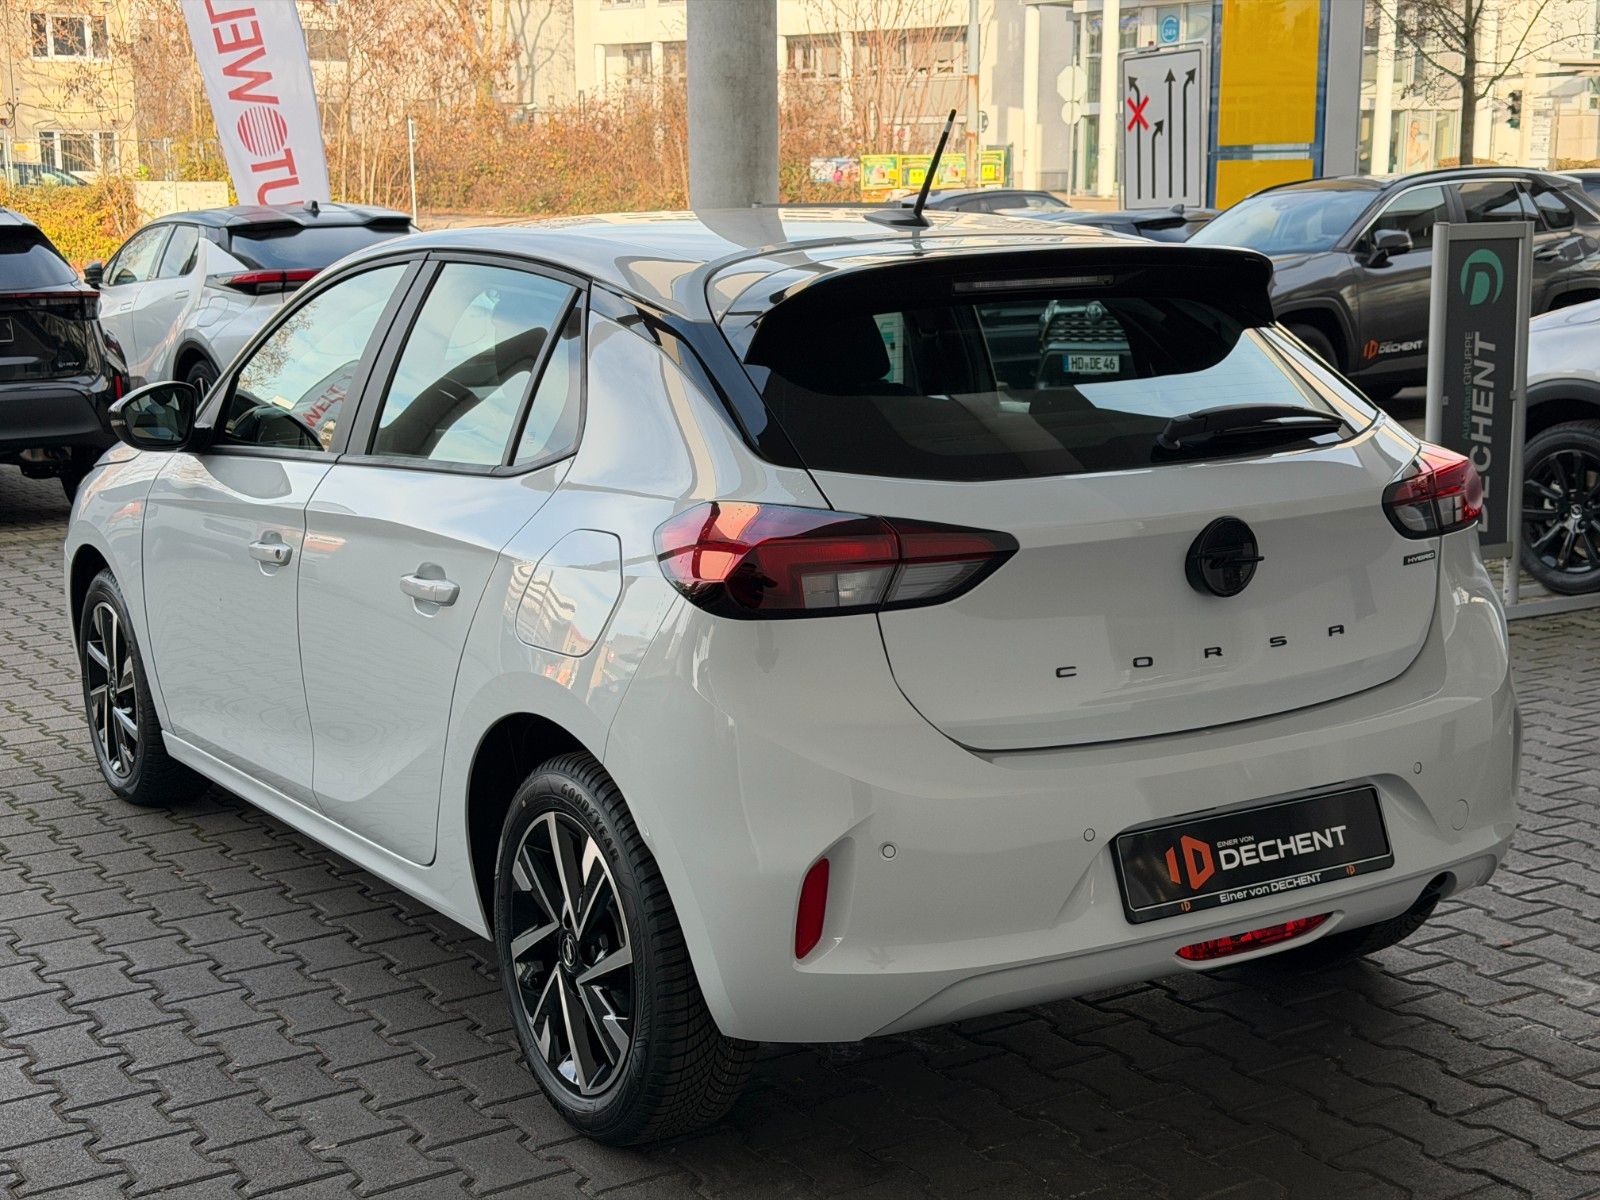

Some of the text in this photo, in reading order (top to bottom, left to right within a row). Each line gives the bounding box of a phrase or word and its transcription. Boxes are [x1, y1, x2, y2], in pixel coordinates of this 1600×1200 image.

[1378, 340, 1423, 354] DECHENT
[1071, 357, 1116, 370] HD DE 46
[1055, 624, 1345, 678] CORSA
[561, 783, 618, 862] GOODYEAR
[1216, 835, 1255, 848] EINER VON
[1218, 825, 1347, 871] DECHENT
[1219, 872, 1322, 903] Einer von DECHENT
